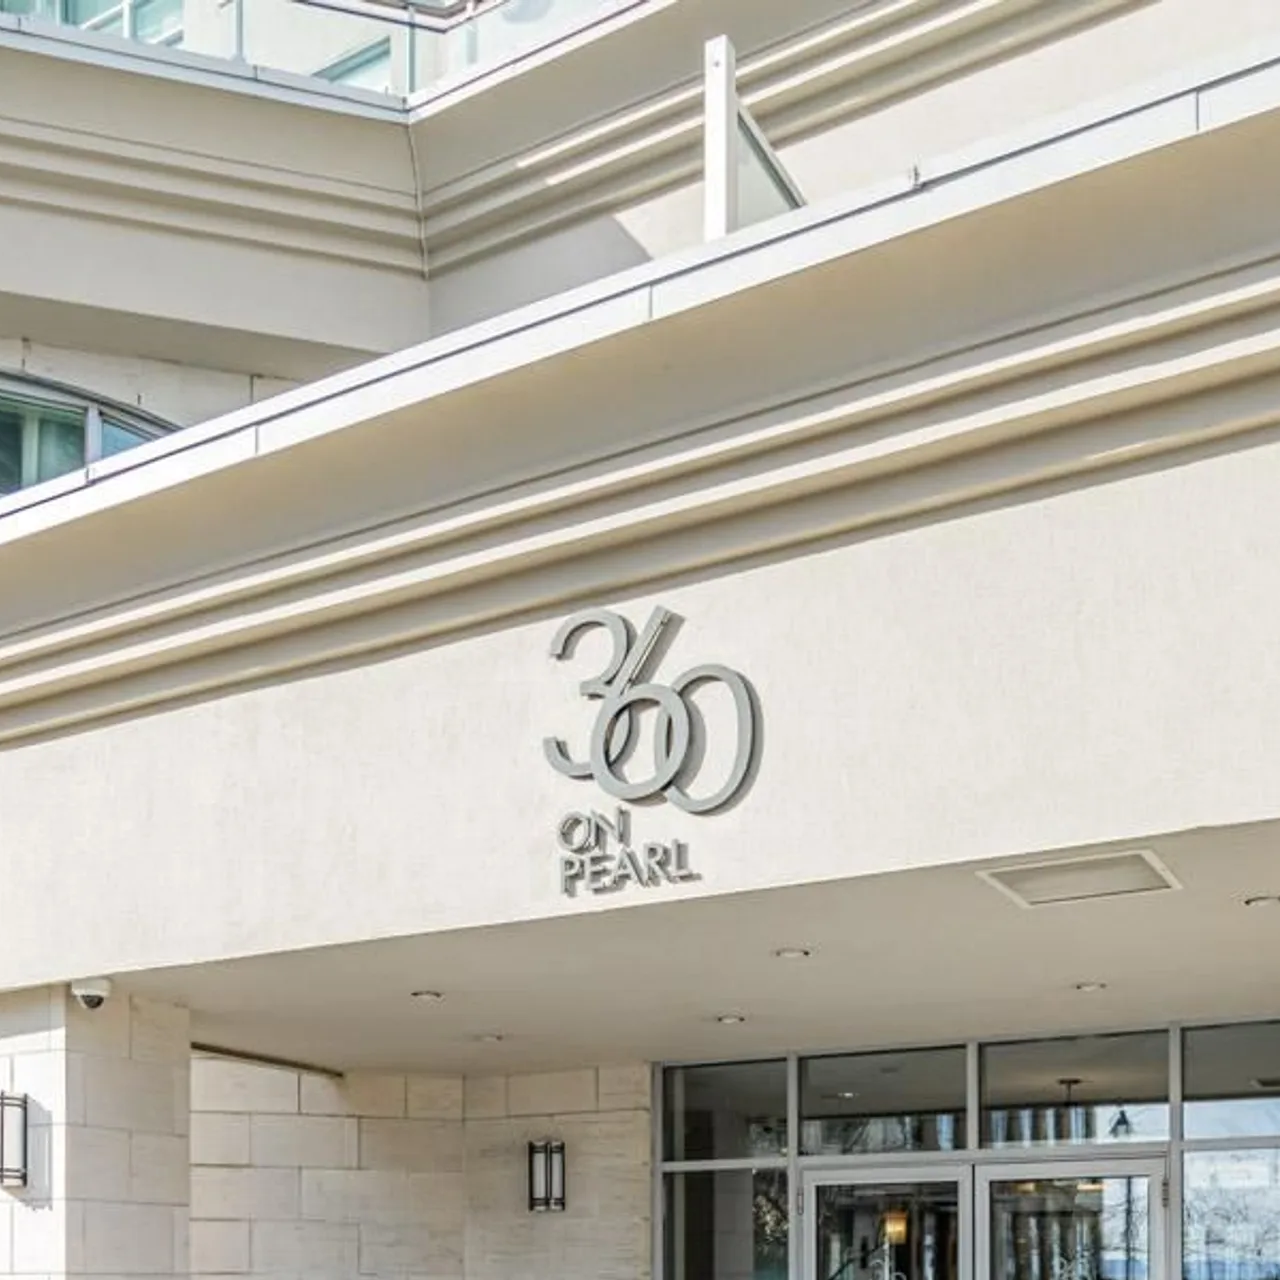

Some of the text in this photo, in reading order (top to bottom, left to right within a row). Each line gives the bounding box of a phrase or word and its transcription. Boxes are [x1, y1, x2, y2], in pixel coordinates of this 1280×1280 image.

[543, 605, 760, 814] 360
[557, 807, 631, 854] ON
[559, 839, 702, 896] PEARL
